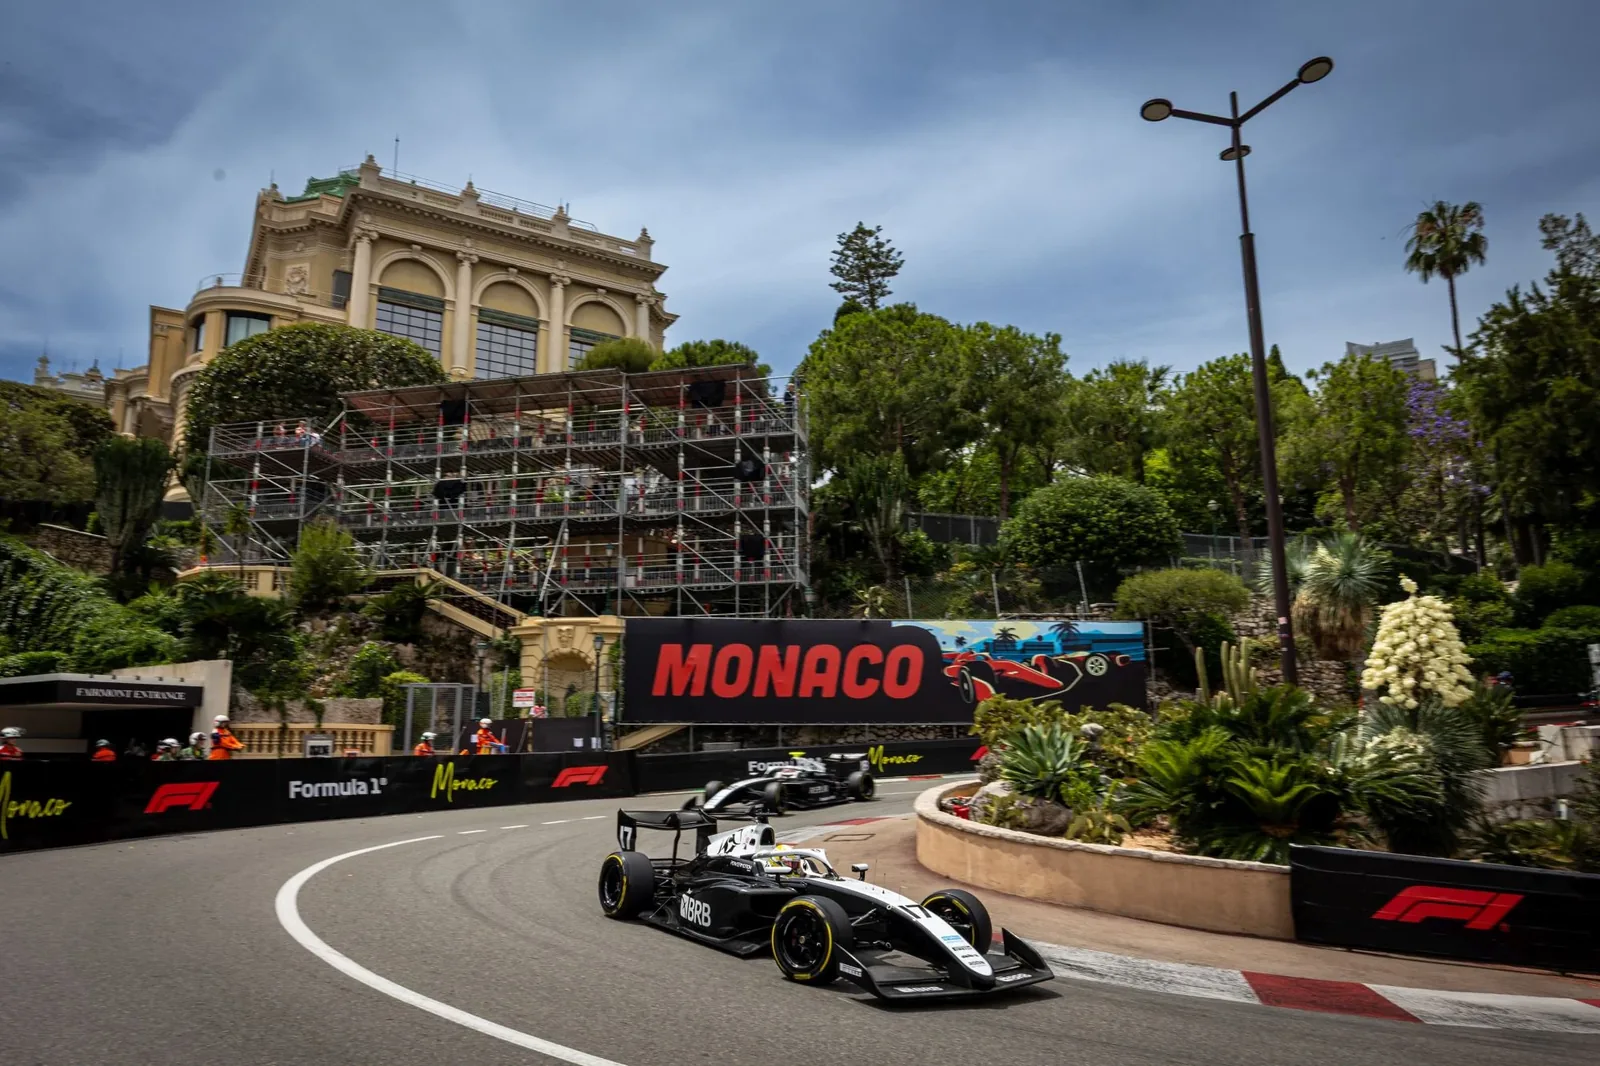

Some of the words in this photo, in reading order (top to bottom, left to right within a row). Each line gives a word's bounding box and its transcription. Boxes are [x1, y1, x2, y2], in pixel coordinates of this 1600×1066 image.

[652, 643, 924, 699] MONACO
[867, 745, 923, 772] Monaco
[289, 779, 368, 799] Formula
[430, 762, 497, 802] Monaco
[551, 765, 608, 788] F1
[144, 782, 219, 813] F1
[620, 825, 633, 850] 17
[688, 897, 711, 927] BRB
[898, 904, 932, 919] 17
[1372, 885, 1524, 930] F1
